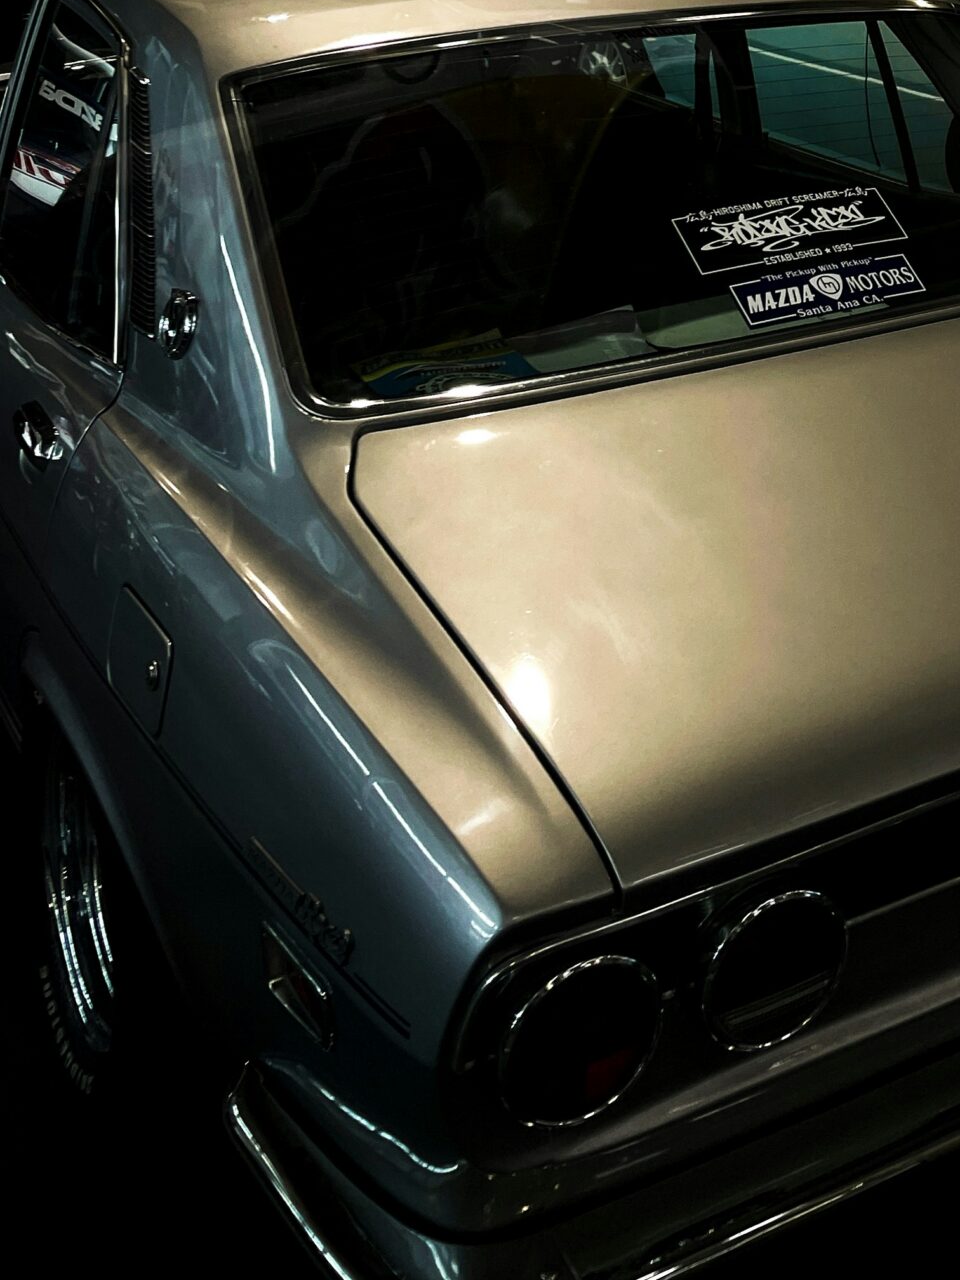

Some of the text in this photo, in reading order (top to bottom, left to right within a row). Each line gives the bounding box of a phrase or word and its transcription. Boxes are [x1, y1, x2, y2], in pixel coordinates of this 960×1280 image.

[714, 201, 763, 217] HIROSHIMA
[764, 197, 791, 209] DRIFT
[792, 189, 840, 204] SCREAMER
[763, 242, 854, 266] ESTABLISHED 1993
[785, 265, 817, 281] Pickup
[818, 262, 840, 274] With
[746, 266, 915, 315] MAZDA MOTORS
[796, 304, 834, 318] Santa
[836, 298, 861, 310] Ana
